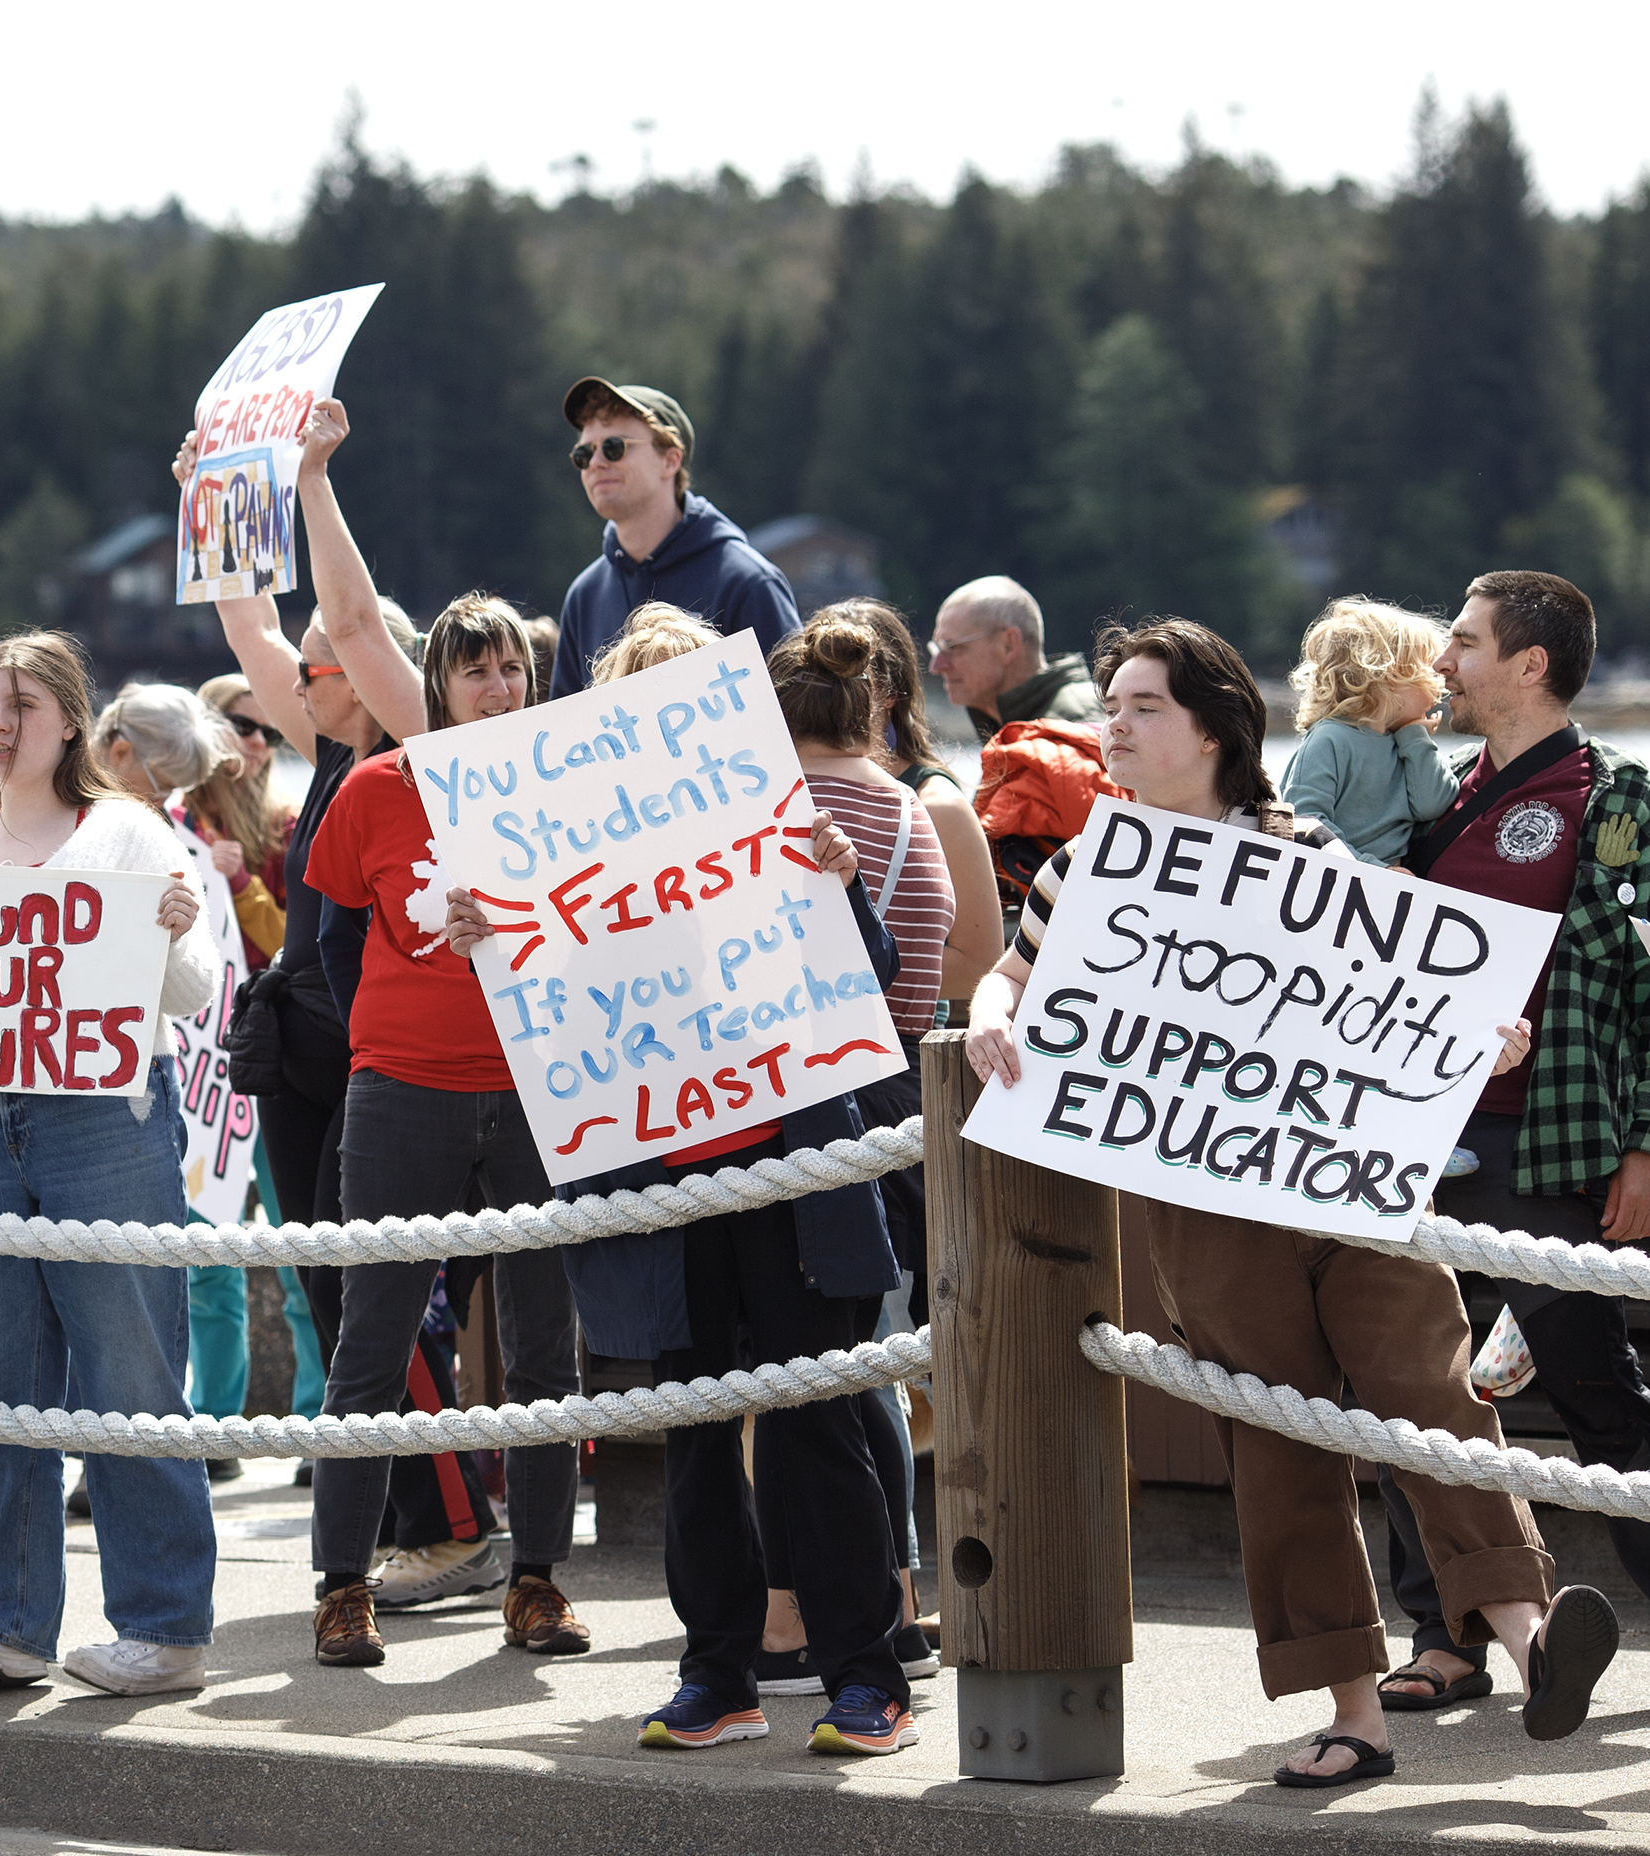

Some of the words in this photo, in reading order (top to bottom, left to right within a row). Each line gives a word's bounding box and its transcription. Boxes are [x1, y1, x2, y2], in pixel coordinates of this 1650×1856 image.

[195, 397, 230, 459] WE
[220, 392, 272, 451] ARE
[182, 475, 223, 550] NOT
[229, 472, 293, 562] PAWNS
[424, 756, 518, 827] You
[532, 704, 640, 782] Can't
[656, 660, 751, 758] put
[492, 744, 770, 881] Students
[547, 825, 779, 946] FIRST
[1497, 802, 1526, 829] KAYHI
[1528, 800, 1549, 811] PEP
[1548, 806, 1565, 833] BAND
[1091, 812, 1490, 976] DEFUND
[493, 976, 567, 1043] If
[587, 965, 693, 1038] you
[717, 888, 814, 992] put
[1082, 904, 1485, 1101] Stoopidity
[634, 1042, 792, 1142] LAST
[1025, 988, 1387, 1129] SUPPORT
[1042, 1071, 1429, 1217] EDUCATORS
